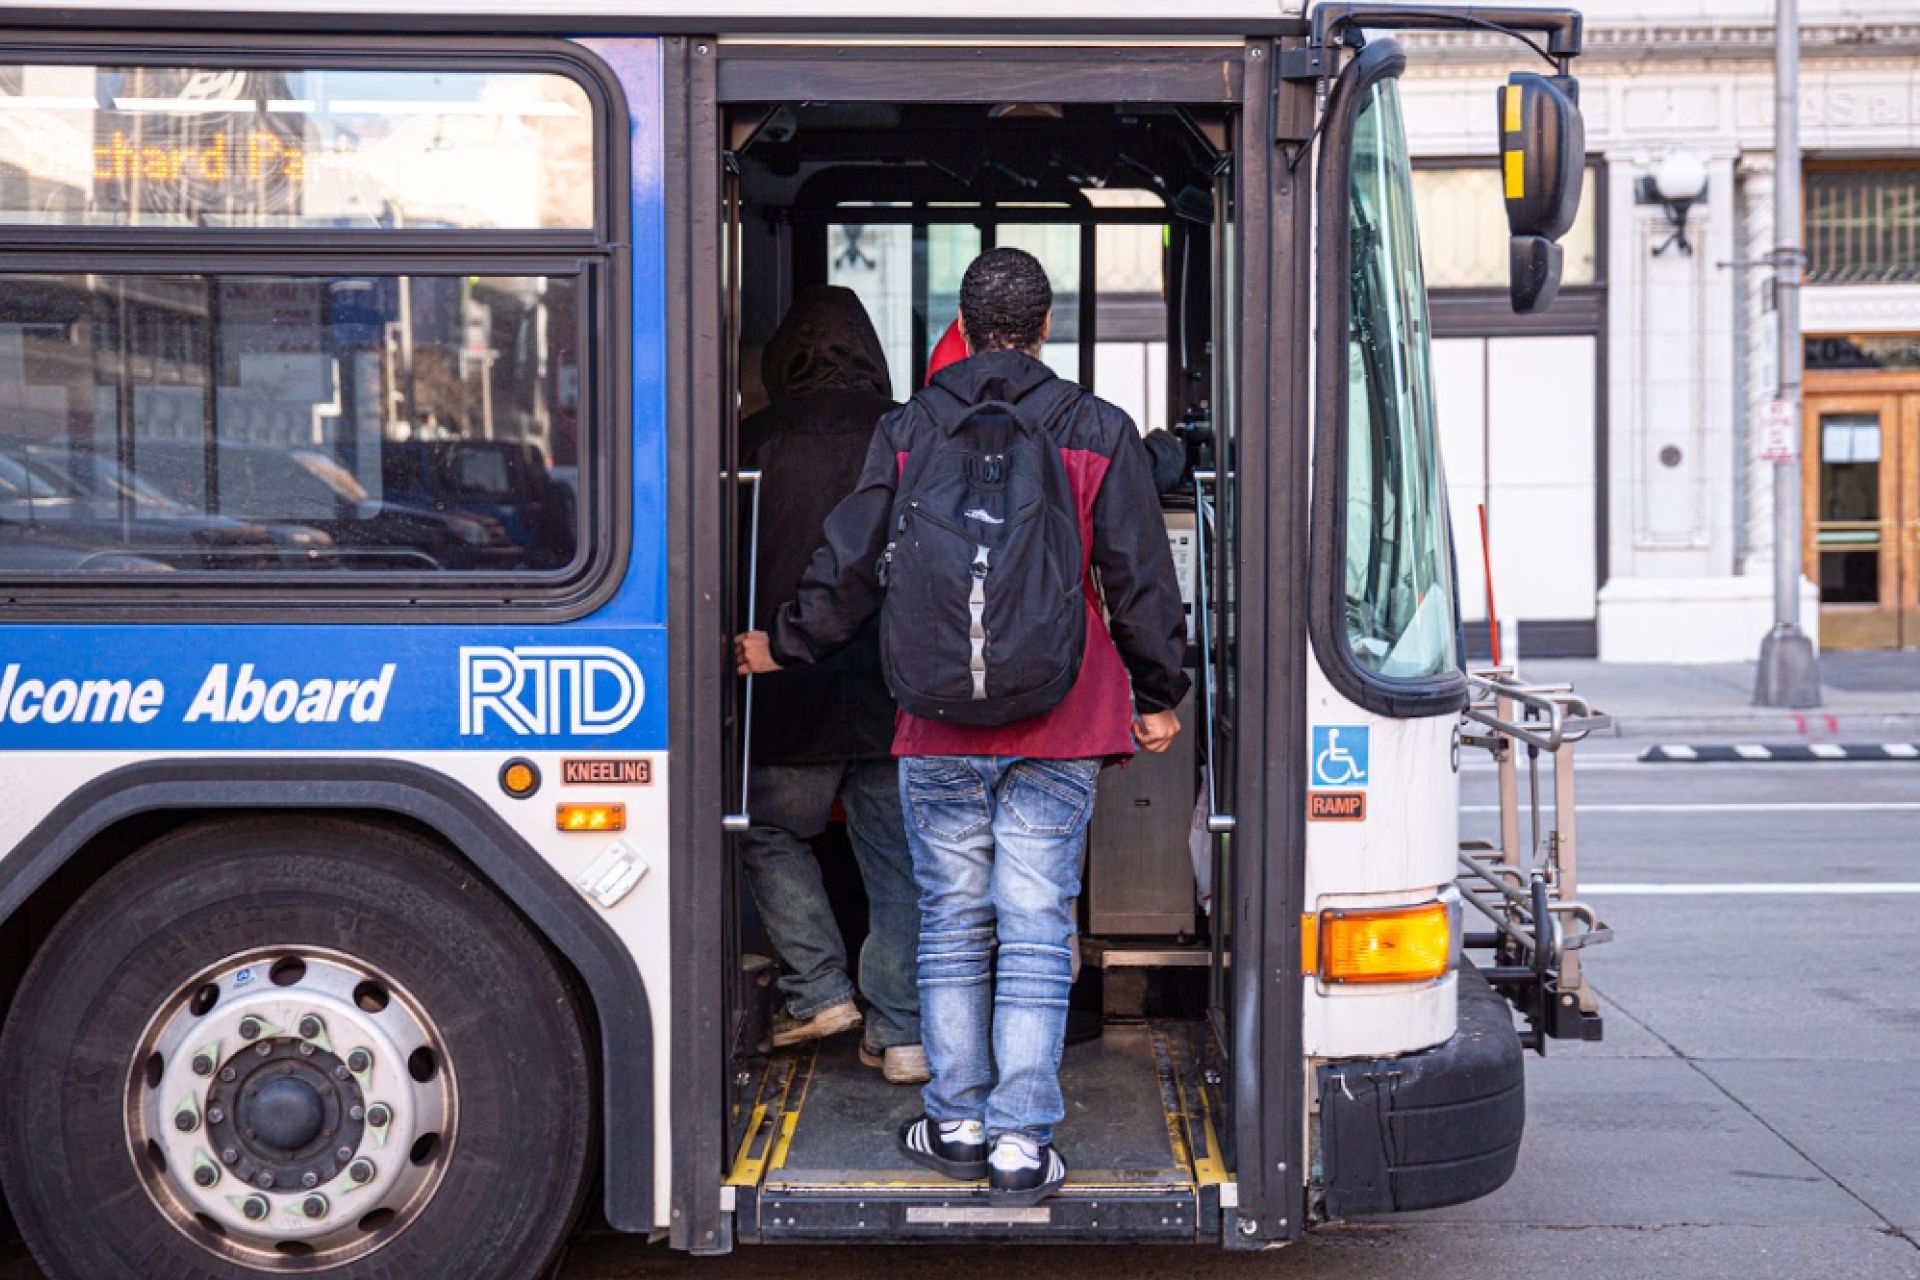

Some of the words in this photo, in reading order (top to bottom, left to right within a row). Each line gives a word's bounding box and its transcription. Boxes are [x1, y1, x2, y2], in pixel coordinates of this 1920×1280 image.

[0, 663, 165, 723] lcome
[183, 663, 398, 723] Aboard
[459, 645, 646, 735] RTD
[566, 762, 649, 782] KNEELING
[1313, 796, 1361, 815] RAMP
